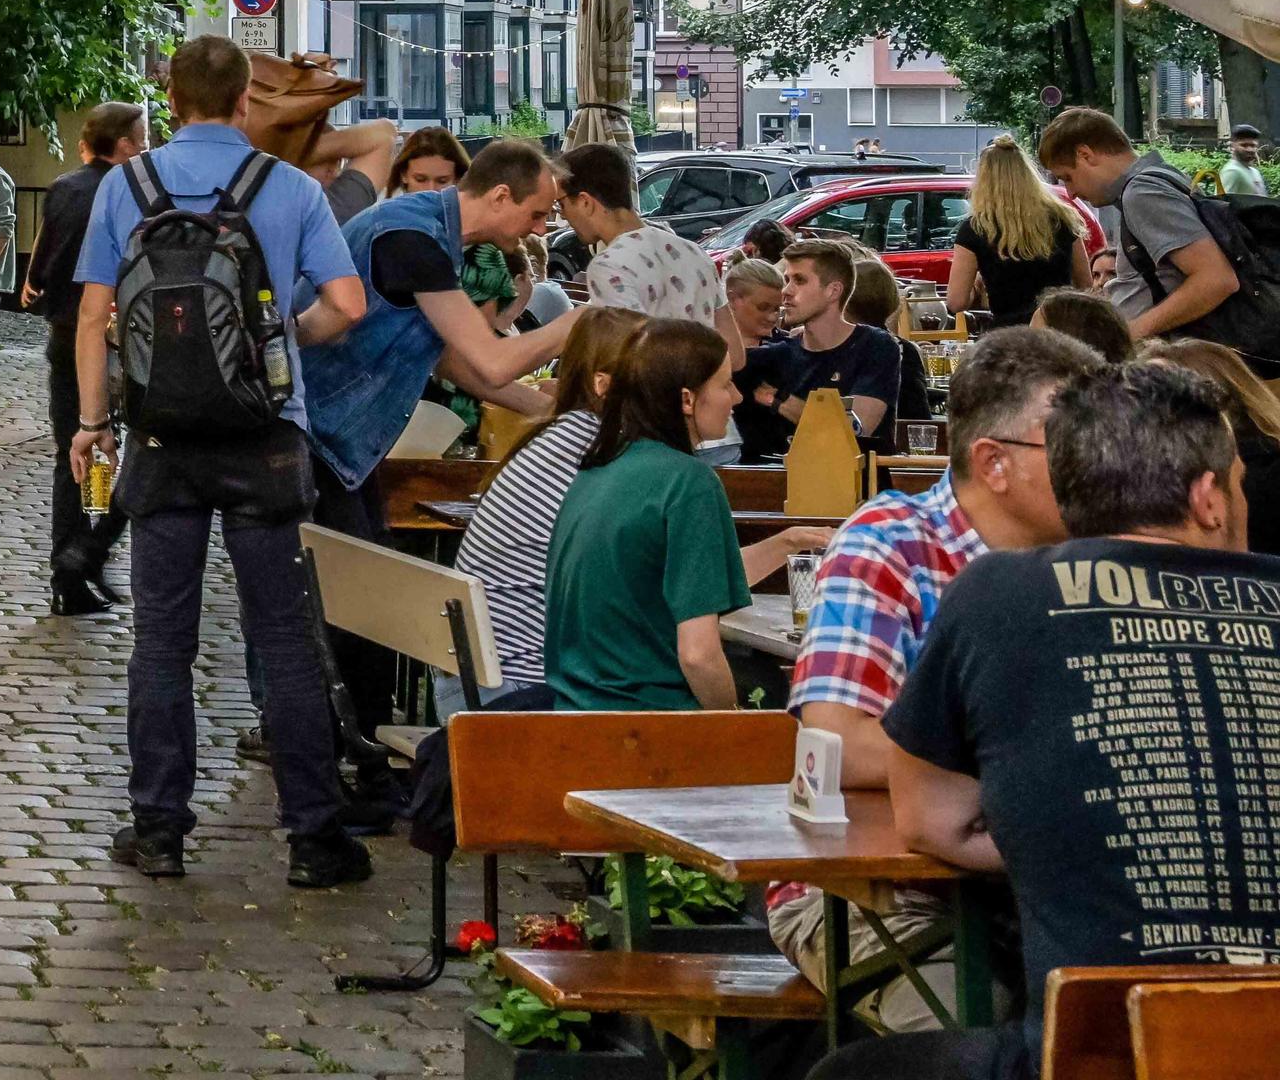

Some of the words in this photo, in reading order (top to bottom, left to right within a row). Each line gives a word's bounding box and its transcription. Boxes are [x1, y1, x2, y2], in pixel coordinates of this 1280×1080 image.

[1110, 617, 1210, 645] EUROPE
[1217, 621, 1275, 650] 2019
[1129, 679, 1172, 691] LONDON
[1156, 767, 1190, 779] PARIS
[1152, 799, 1196, 812] MADRID
[1158, 814, 1198, 828] LISBON
[1168, 847, 1204, 860] MILAN
[1157, 863, 1205, 877] WARSAW
[1165, 880, 1208, 894] PRAGUE
[1170, 896, 1209, 910] BERLIN
[1142, 924, 1202, 947] REWIND
[1210, 925, 1263, 946] REPLAY
